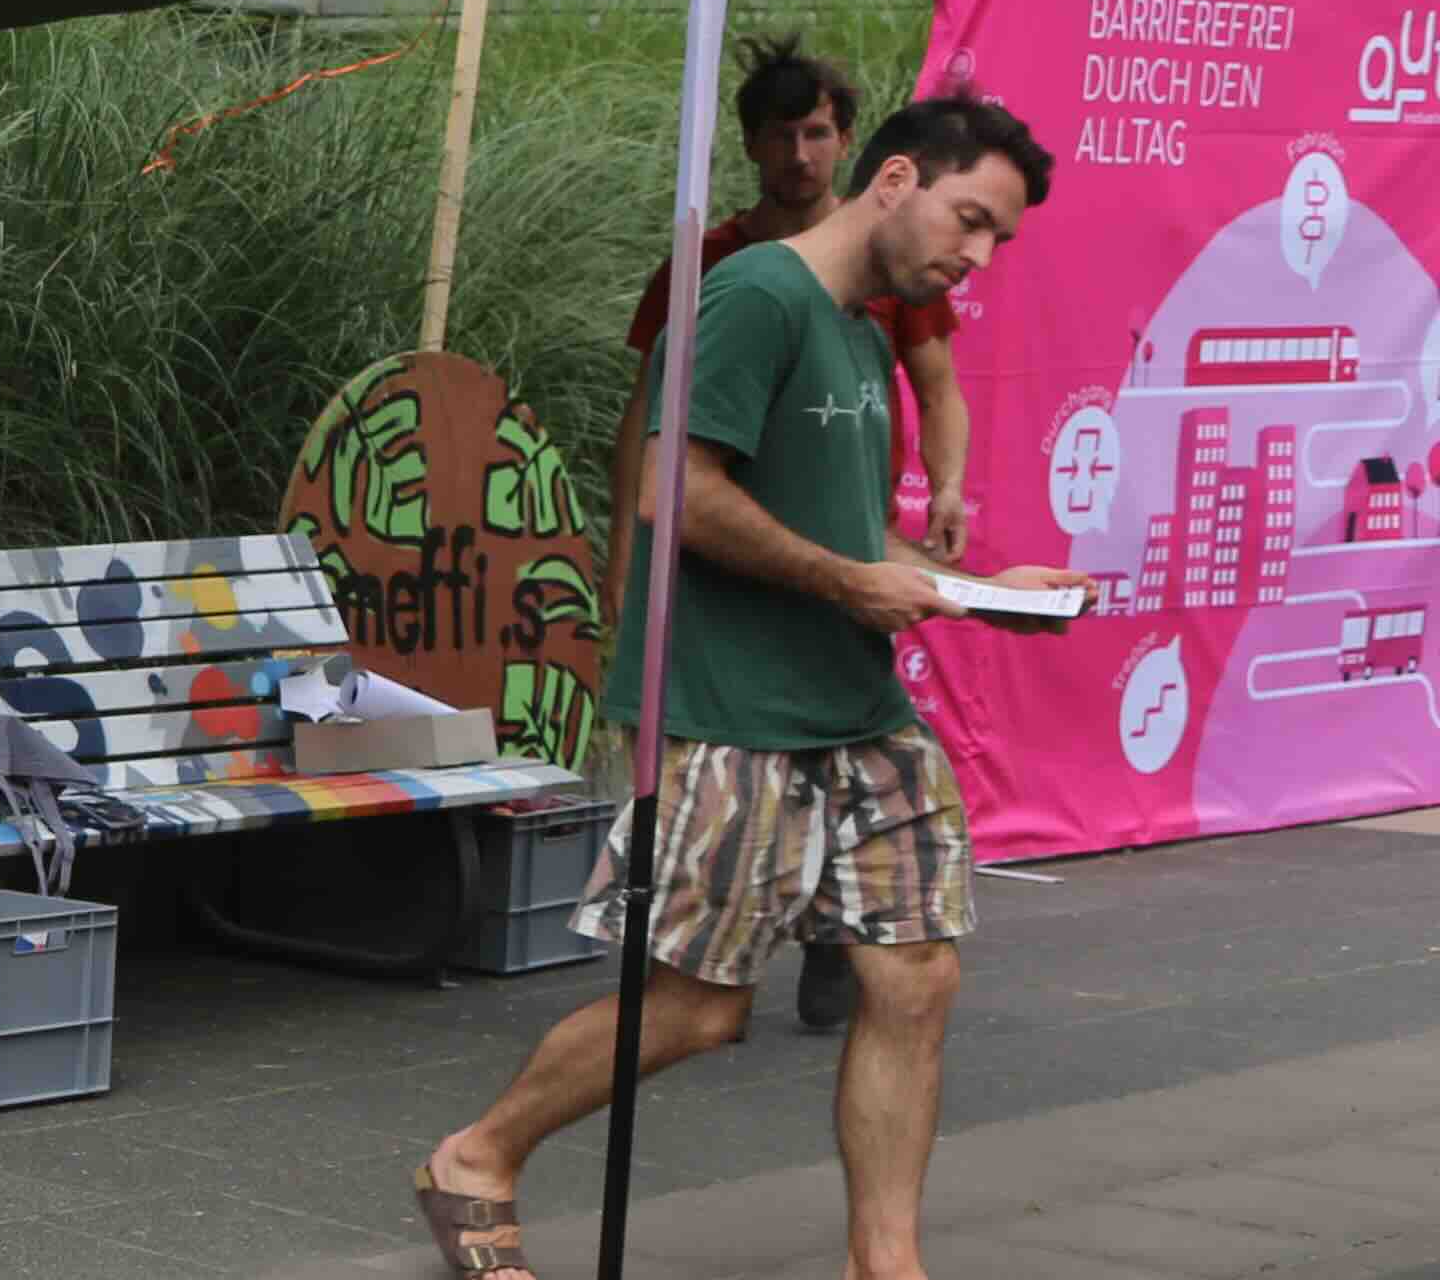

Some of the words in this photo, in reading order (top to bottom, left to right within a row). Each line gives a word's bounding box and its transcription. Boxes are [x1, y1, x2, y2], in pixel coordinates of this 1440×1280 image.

[1082, 53, 1189, 106] DURCH
[1198, 61, 1263, 108] DEN
[1075, 117, 1186, 166] ALLTAG
